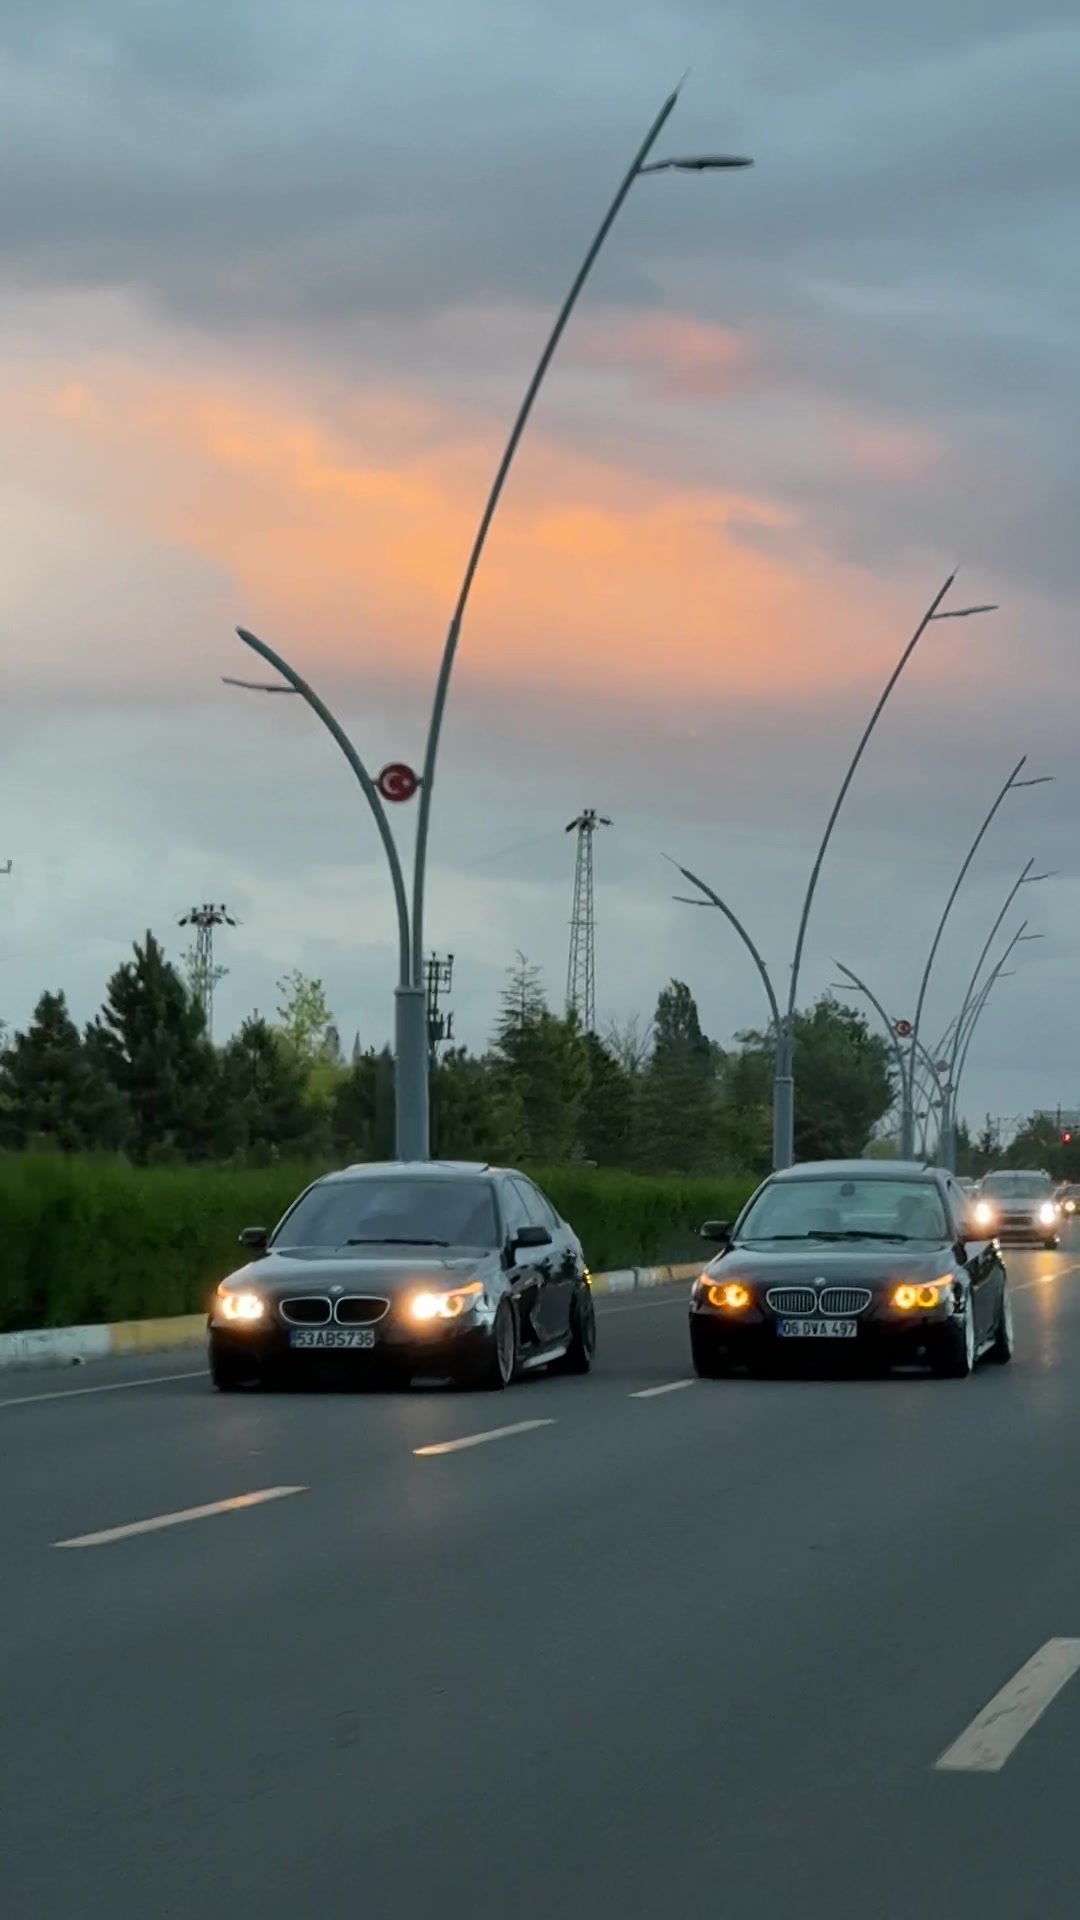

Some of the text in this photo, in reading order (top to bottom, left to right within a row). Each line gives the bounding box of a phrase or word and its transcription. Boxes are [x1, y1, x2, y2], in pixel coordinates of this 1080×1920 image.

[783, 1322, 855, 1335] 06 DVA 497
[297, 1332, 373, 1346] 53ABS736
